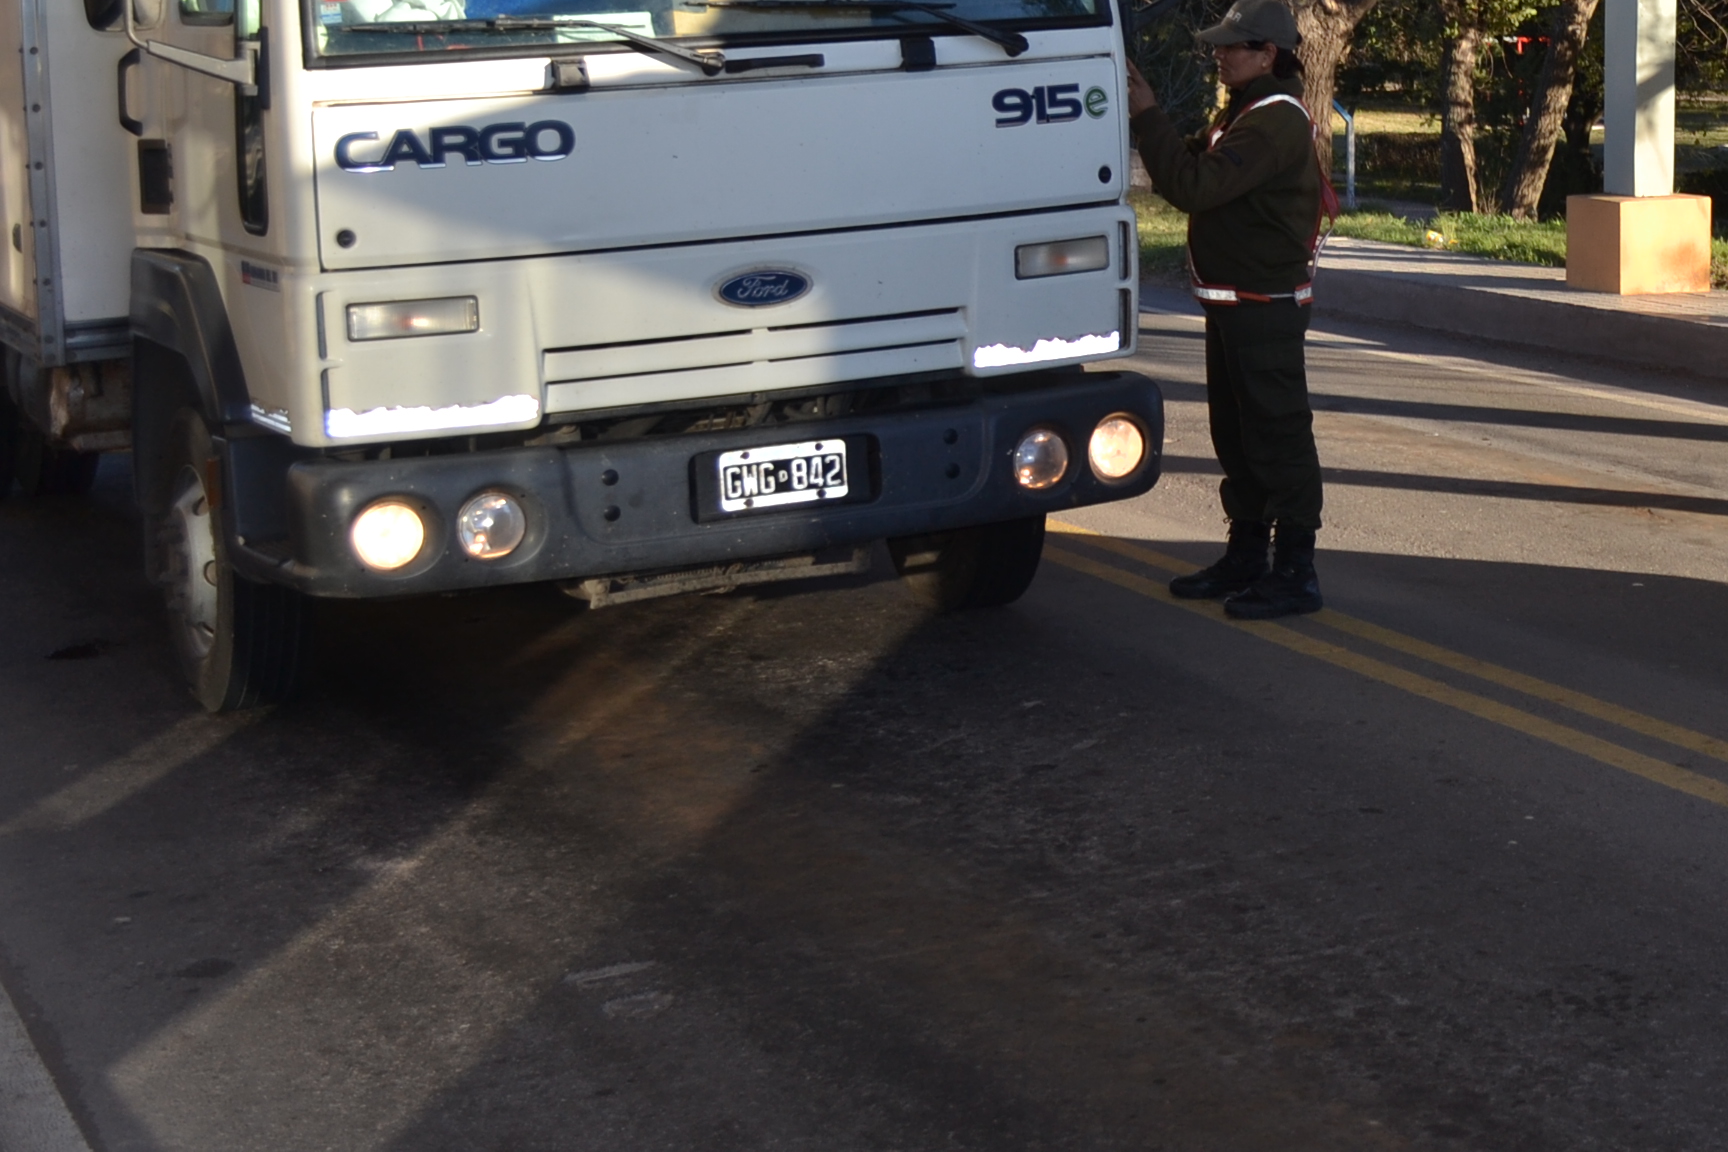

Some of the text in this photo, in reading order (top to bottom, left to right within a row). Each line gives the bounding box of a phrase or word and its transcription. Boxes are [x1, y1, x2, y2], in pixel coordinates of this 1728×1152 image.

[334, 119, 576, 174] CARGO
[737, 275, 790, 299] Ford
[725, 461, 777, 499] GWG
[790, 454, 842, 490] 842
